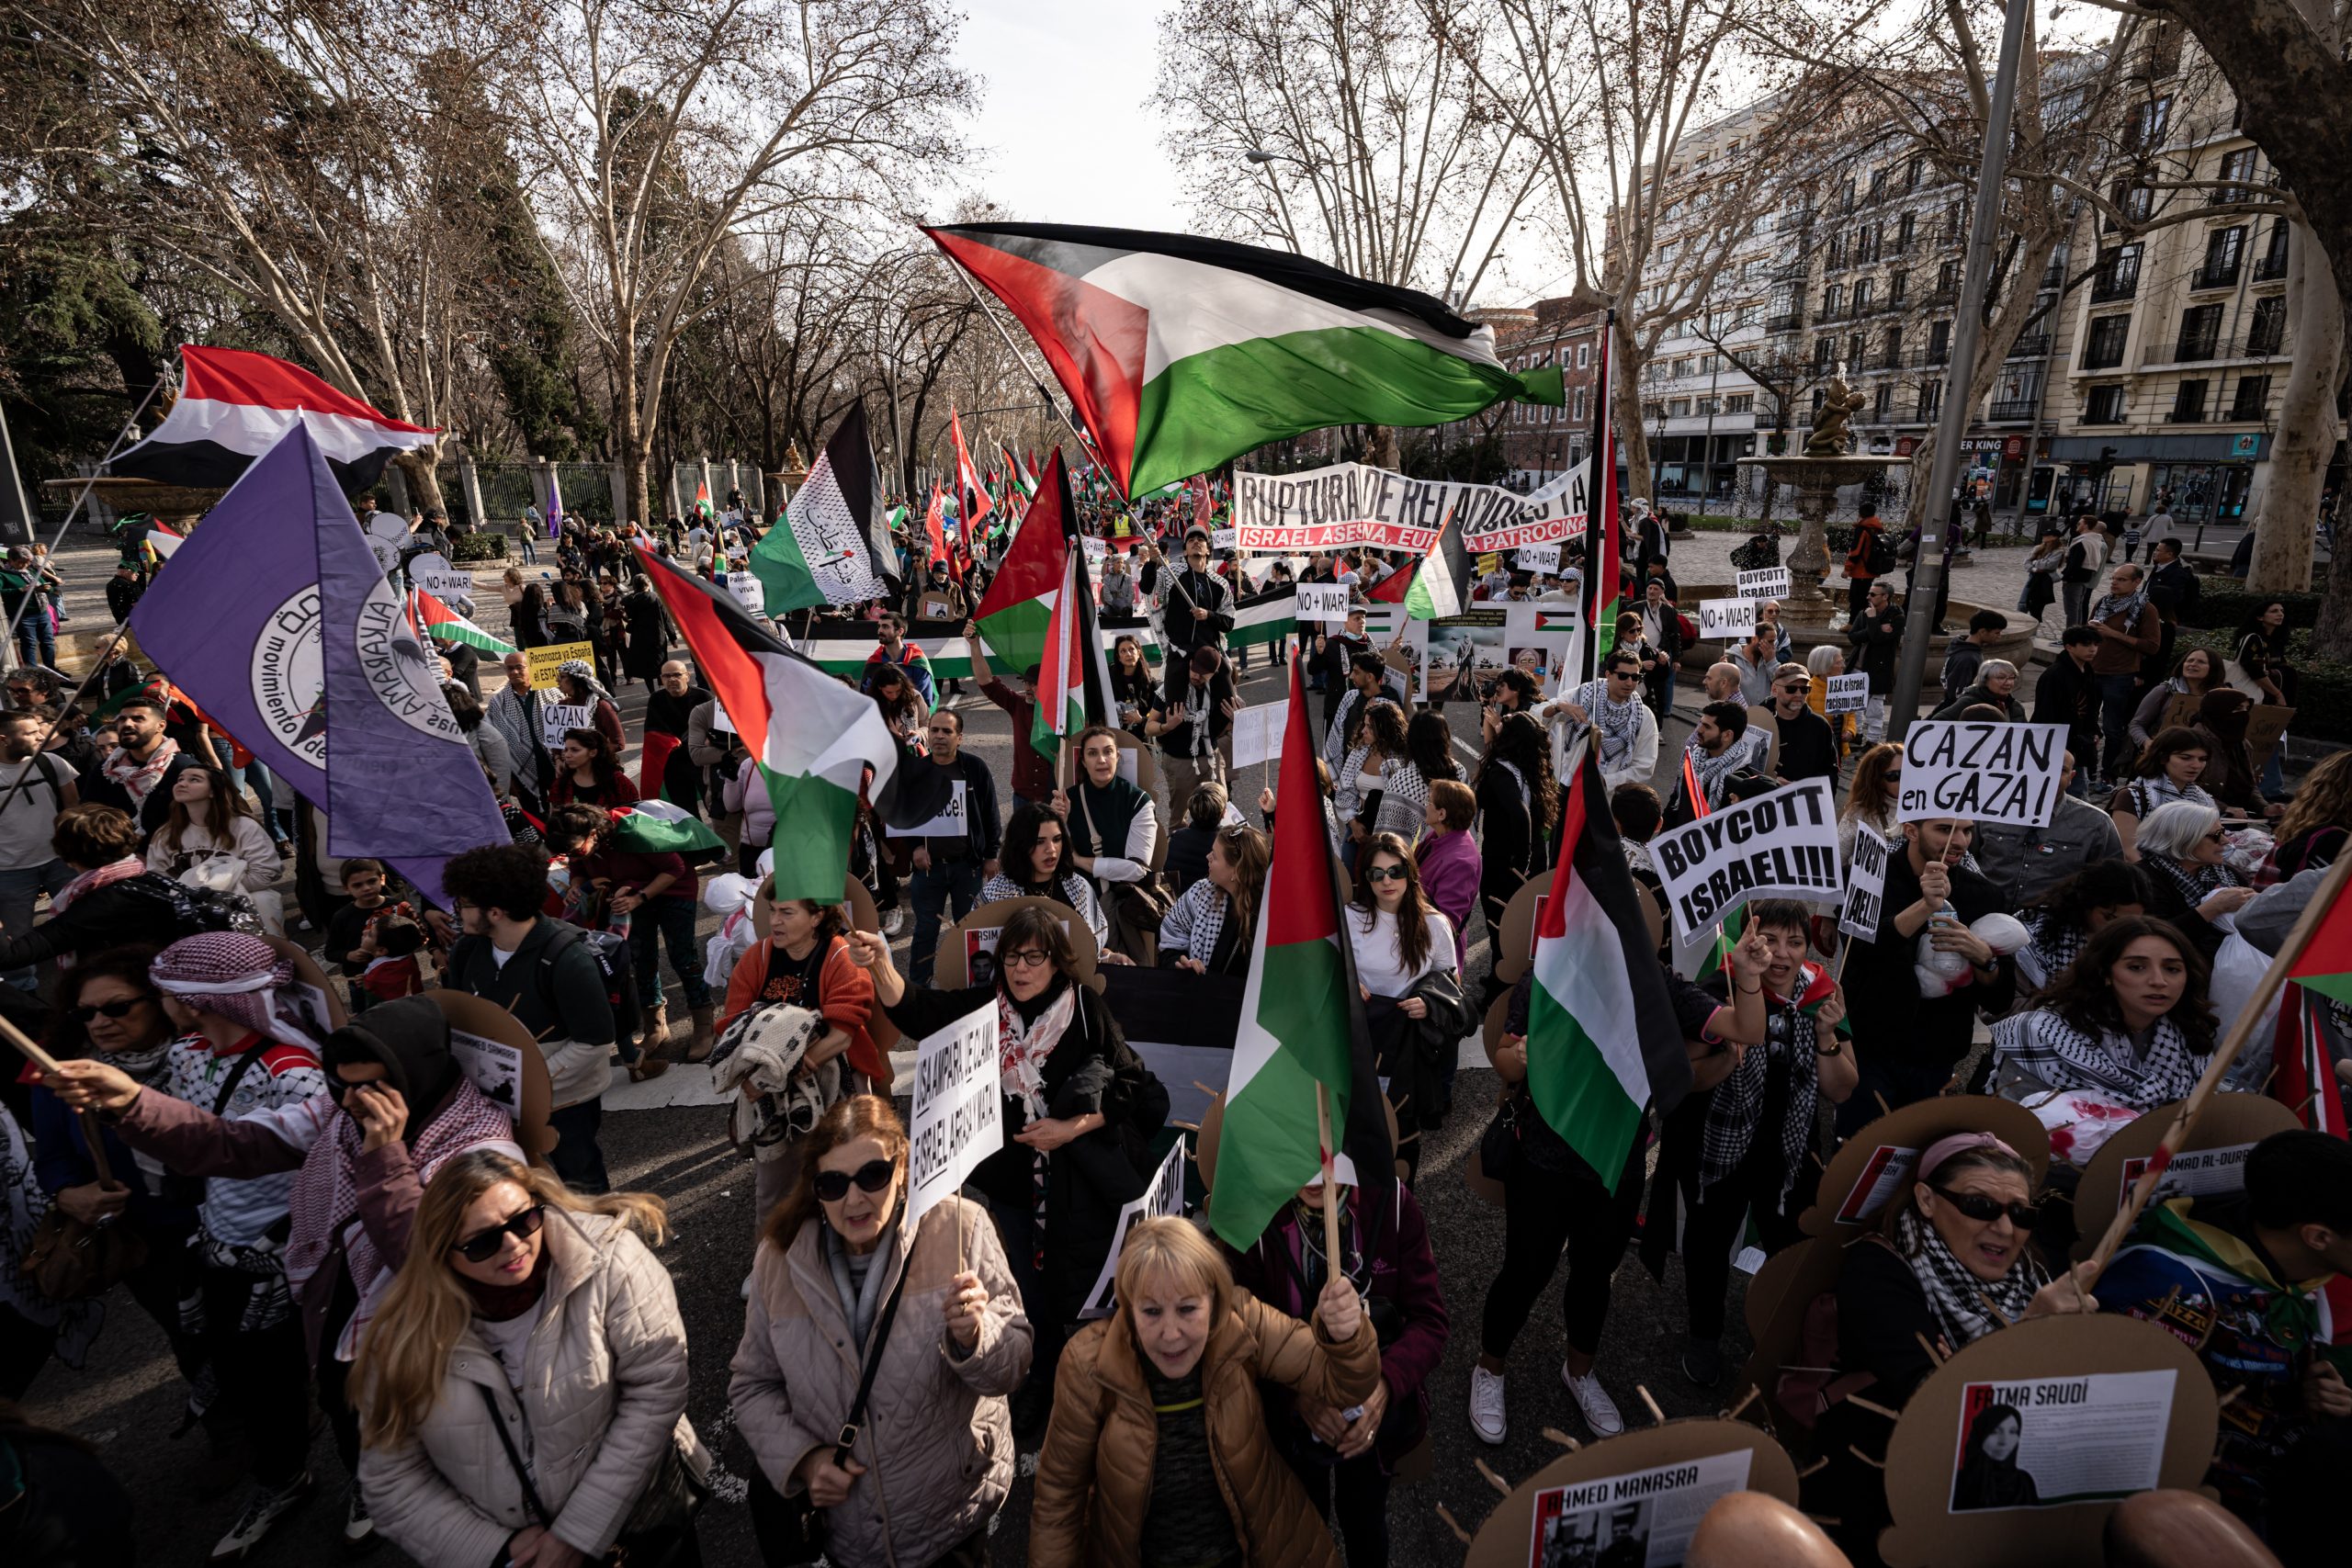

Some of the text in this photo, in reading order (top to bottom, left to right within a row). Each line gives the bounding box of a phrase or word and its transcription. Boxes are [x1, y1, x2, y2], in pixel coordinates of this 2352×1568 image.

[1975, 440, 2002, 450] KING
[1241, 469, 1362, 526] RUPTURA
[1363, 468, 1398, 522] DE
[1241, 525, 1315, 547] ISRAEL
[1483, 516, 1588, 551] PATROCINA
[1519, 549, 1559, 567] NO + WAR!
[426, 576, 470, 590] NO + WAR!
[1739, 569, 1785, 584] BOYCOTT
[739, 586, 754, 594] VIVA
[1740, 584, 1787, 599] ISRAEL!!!
[1297, 592, 1348, 612] NO + WAR!
[1701, 607, 1754, 628] NO + WAR!
[561, 650, 570, 661] ya
[570, 645, 592, 660] España
[534, 670, 539, 682] el
[1844, 681, 1849, 692] e
[261, 636, 327, 760] movimiento de
[1826, 695, 1850, 710] racismo
[545, 705, 584, 727] CAZAN
[546, 734, 556, 743] en
[1907, 724, 2055, 772] CAZAN
[1901, 772, 2051, 825] en GAZA!
[1657, 785, 1824, 882] BOYCOTT
[1679, 845, 1838, 931] ISRAEL!!!
[971, 930, 999, 942] NASIM
[920, 1118, 947, 1180] ISRAEL
[1974, 1386, 2030, 1409] FATMA
[1547, 1466, 1698, 1513] AHMED MANASRA
